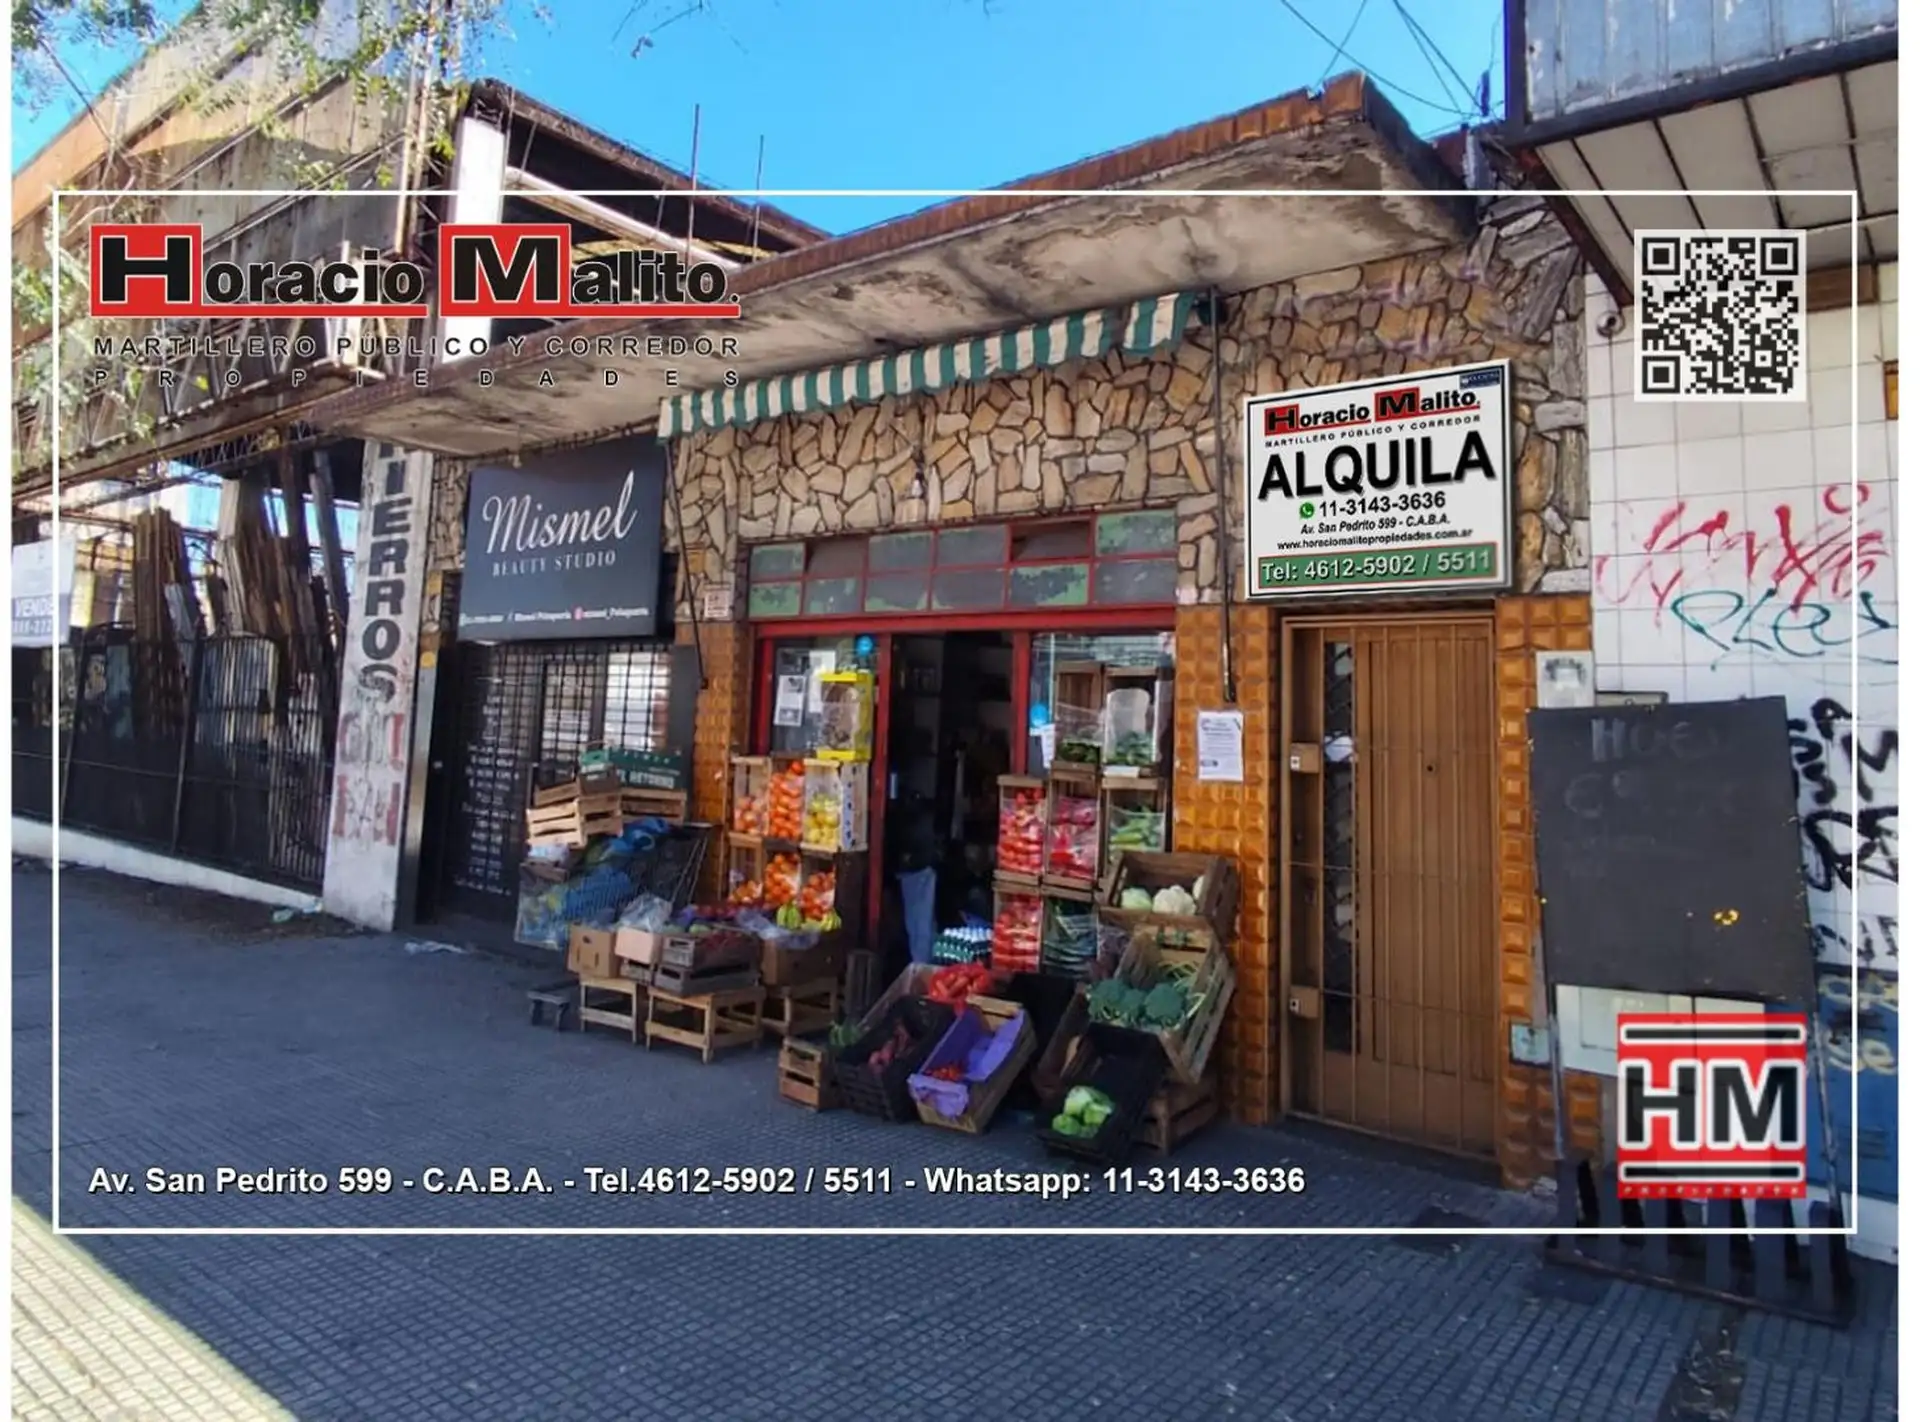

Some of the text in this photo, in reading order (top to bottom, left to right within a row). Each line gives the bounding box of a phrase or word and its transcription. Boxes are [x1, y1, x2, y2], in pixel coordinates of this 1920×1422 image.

[1265, 414, 1481, 449] MARTILLERO PÚBLICO Y CORREDOR
[1268, 403, 1370, 431] Horacio
[1258, 430, 1496, 502] ALQUILA
[482, 470, 638, 554] Mismel
[1319, 491, 1446, 518] 11-3143-3636
[1301, 523, 1315, 536] Av.
[1318, 521, 1337, 534] San
[1340, 519, 1376, 533] Pedrito
[1378, 517, 1397, 530] 599
[1406, 513, 1450, 527] C.A.B.A.
[492, 550, 616, 577] BEAUTY STUDIO
[1262, 551, 1491, 581] Tel: 4612-5902 / 5511
